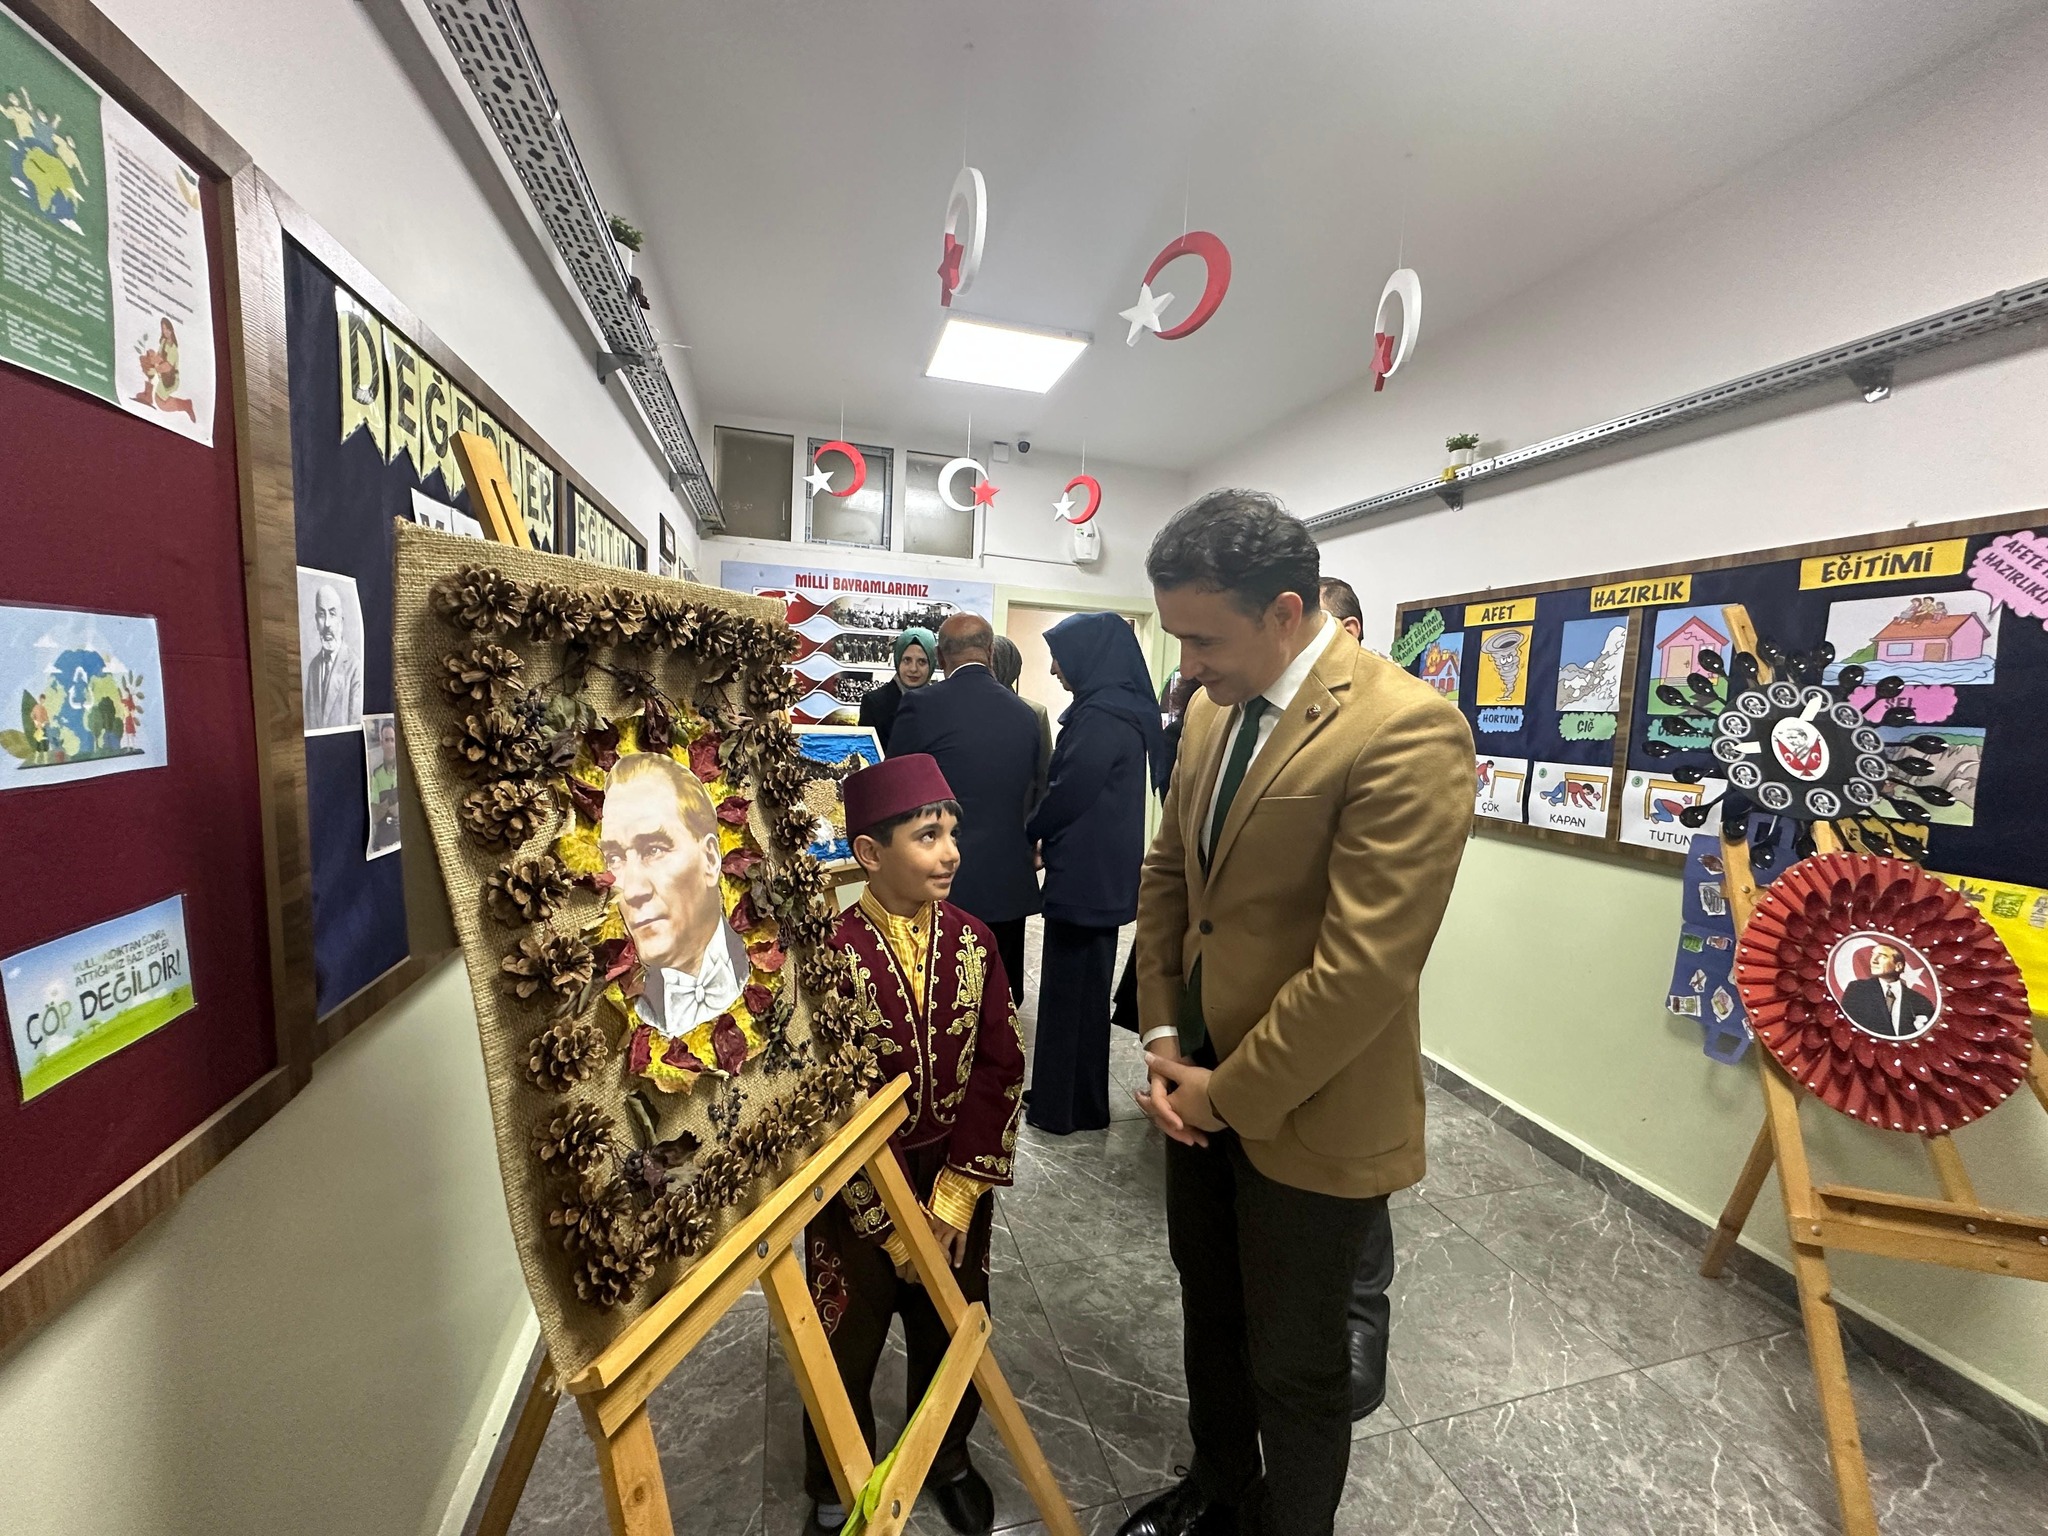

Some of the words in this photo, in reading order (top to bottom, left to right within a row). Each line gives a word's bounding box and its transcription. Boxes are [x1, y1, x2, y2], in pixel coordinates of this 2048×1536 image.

[1821, 547, 1934, 583] EĞİTİMİ
[795, 572, 829, 590] MİLLİ
[833, 577, 929, 597] BAYRAMLARIMIZ
[1594, 581, 1685, 608] HAZIRLIK
[1481, 605, 1516, 622] AFET
[1397, 635, 1413, 653] AFET
[1396, 644, 1415, 662] HAYAT
[1482, 713, 1519, 725] HORTUM
[1577, 718, 1595, 734] ÇIĞ
[1481, 801, 1499, 814] ÇÖK
[1550, 813, 1586, 828] KAPAN
[1649, 830, 1692, 846] TUTUN
[26, 1002, 72, 1049] ÇÖP
[79, 948, 181, 1020] DEĞİLDİR!
